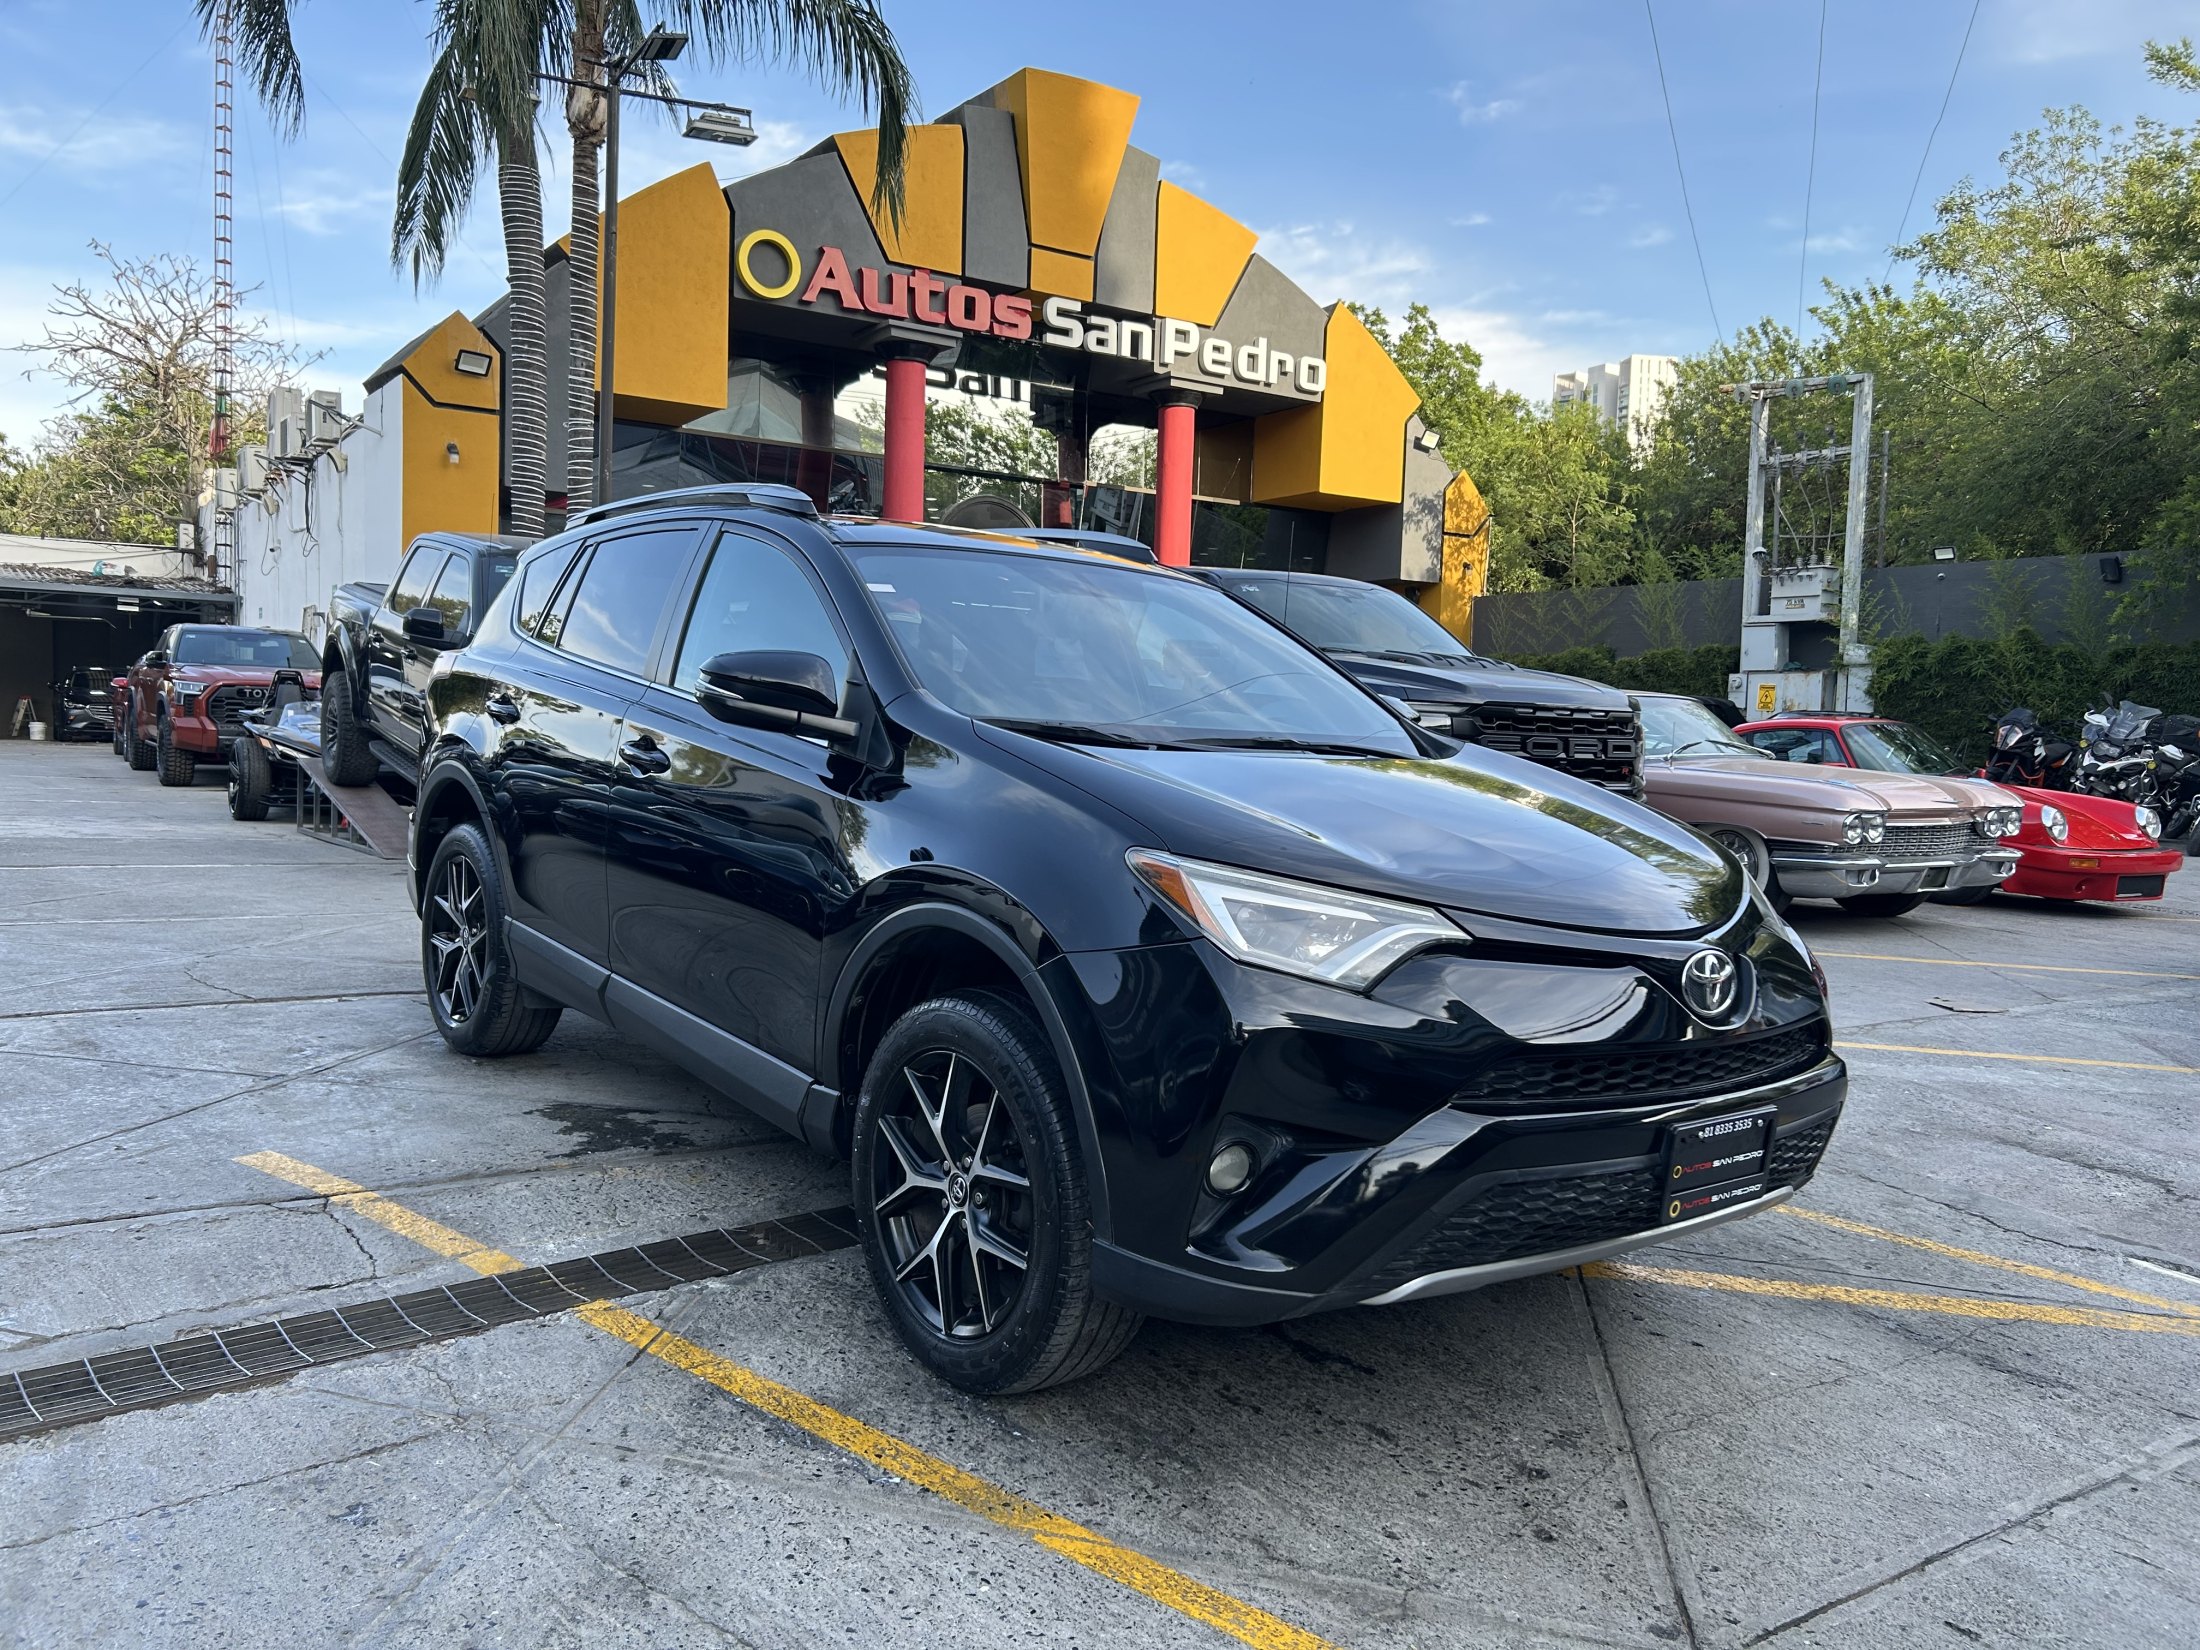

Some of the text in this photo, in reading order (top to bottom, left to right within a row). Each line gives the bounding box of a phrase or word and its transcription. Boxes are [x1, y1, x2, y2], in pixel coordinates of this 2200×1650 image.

[801, 246, 1327, 394] Autos San Pedro
[1480, 734, 1636, 758] FORD
[1714, 1122, 1734, 1135] 8335
[1733, 1118, 1753, 1131] 3535
[1683, 1150, 1763, 1173] AUTOS SAN PEDRO
[1681, 1184, 1762, 1209] AUTOS SAN PEDRO
